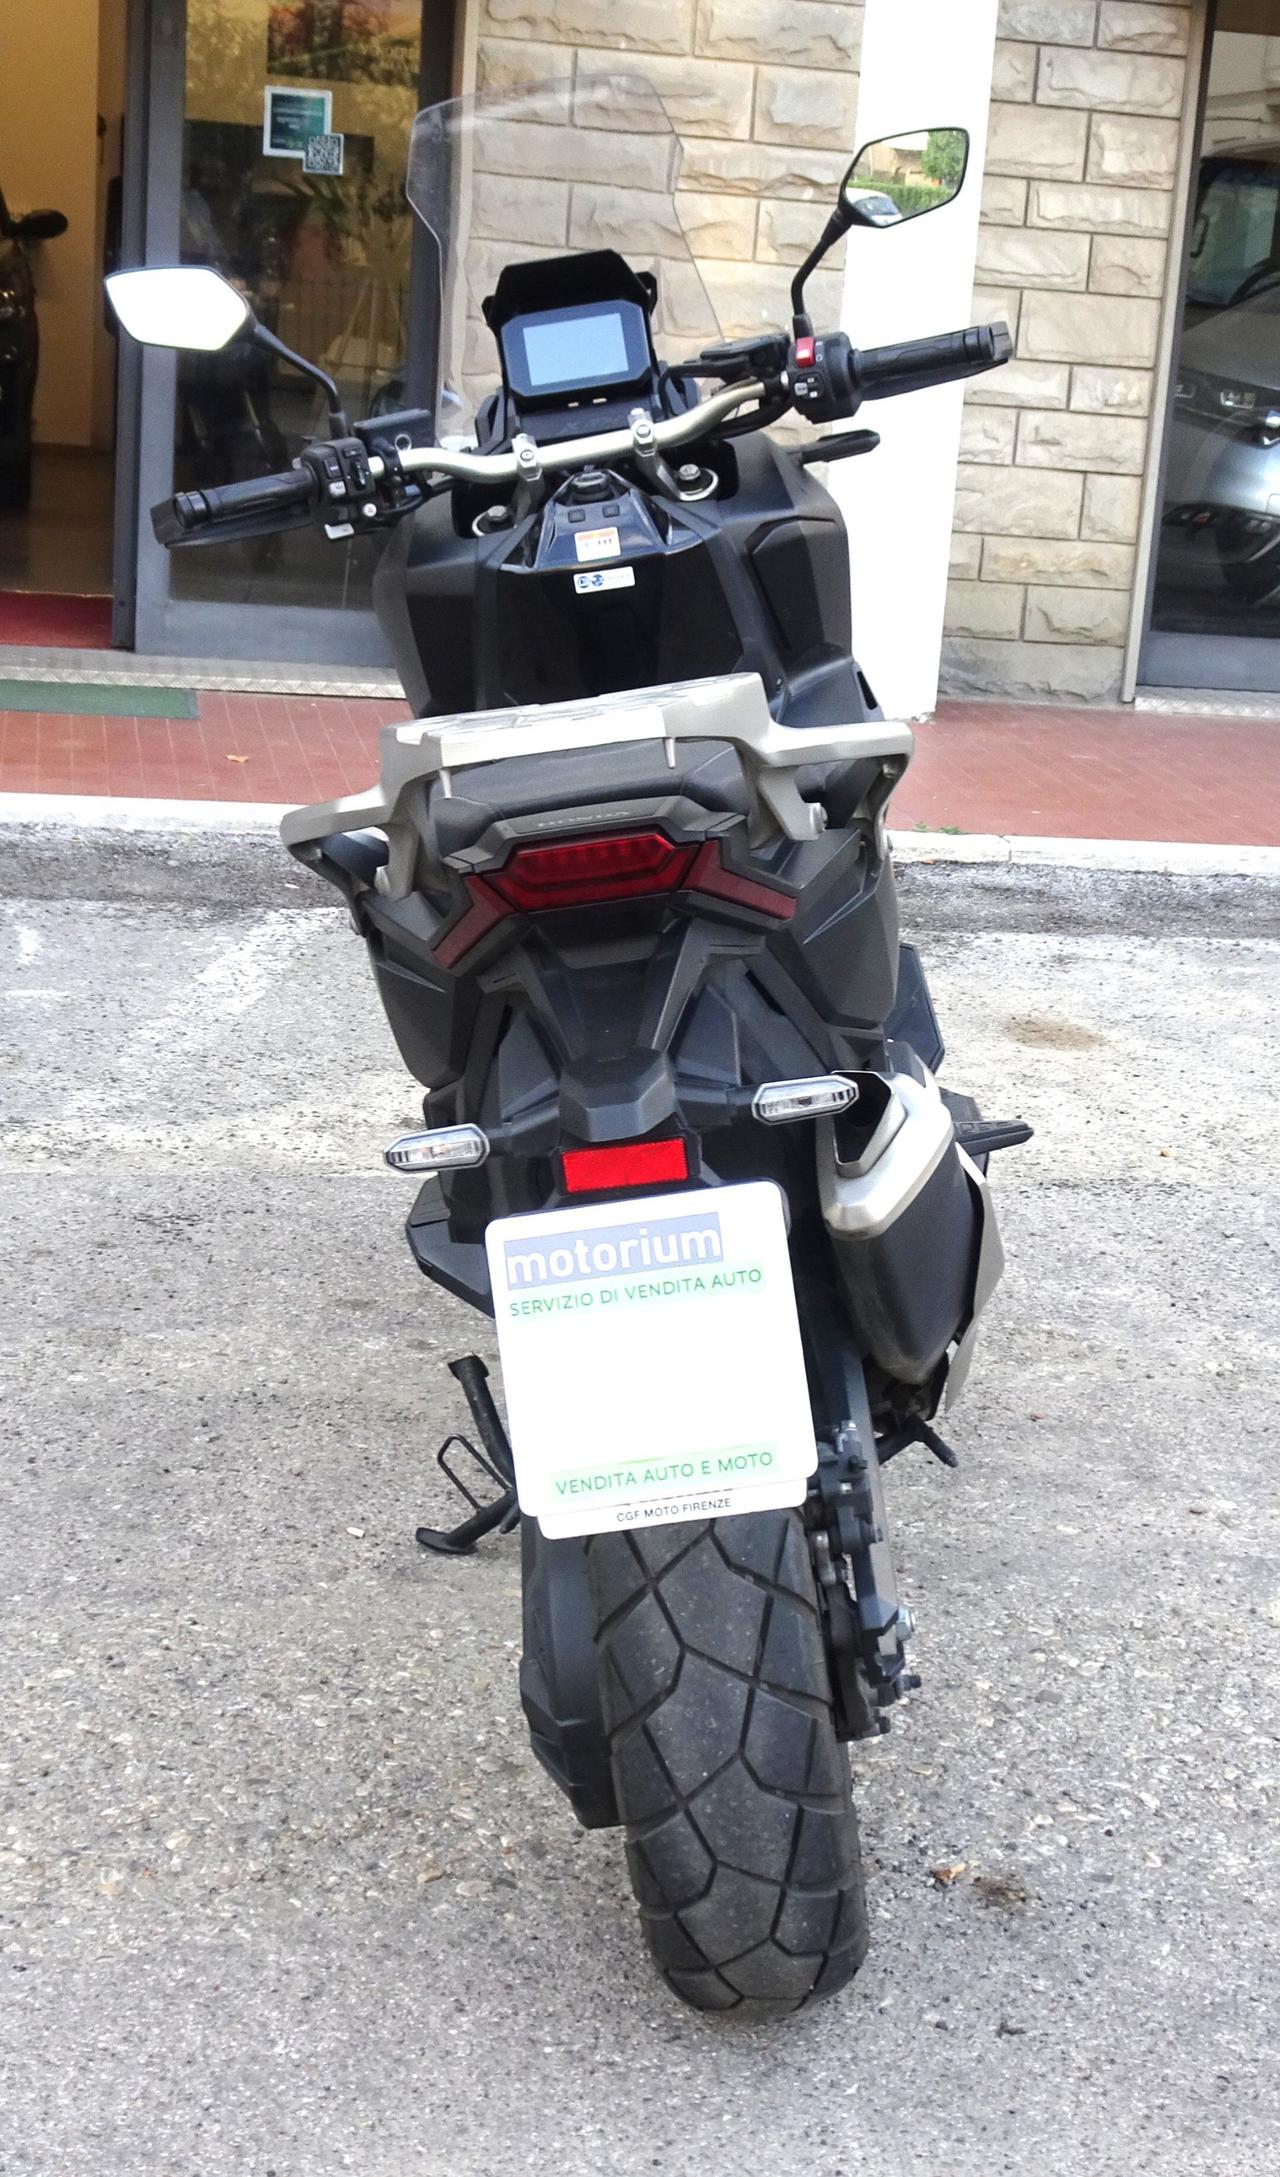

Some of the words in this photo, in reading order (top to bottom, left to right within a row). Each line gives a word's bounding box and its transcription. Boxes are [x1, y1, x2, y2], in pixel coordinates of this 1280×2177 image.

[506, 1228, 721, 1285] motorium
[509, 1292, 594, 1317] SERVIZIO
[600, 1289, 618, 1304] DI
[624, 1277, 706, 1300] VENDITA
[711, 1269, 762, 1289] AUTO
[555, 1471, 638, 1495] VENDITA
[643, 1463, 694, 1483] AUTO
[701, 1460, 712, 1475] E
[718, 1452, 773, 1473] MOTO
[616, 1510, 641, 1522] CGF
[644, 1505, 680, 1518] MOTO
[682, 1498, 732, 1513] FIRENZE
